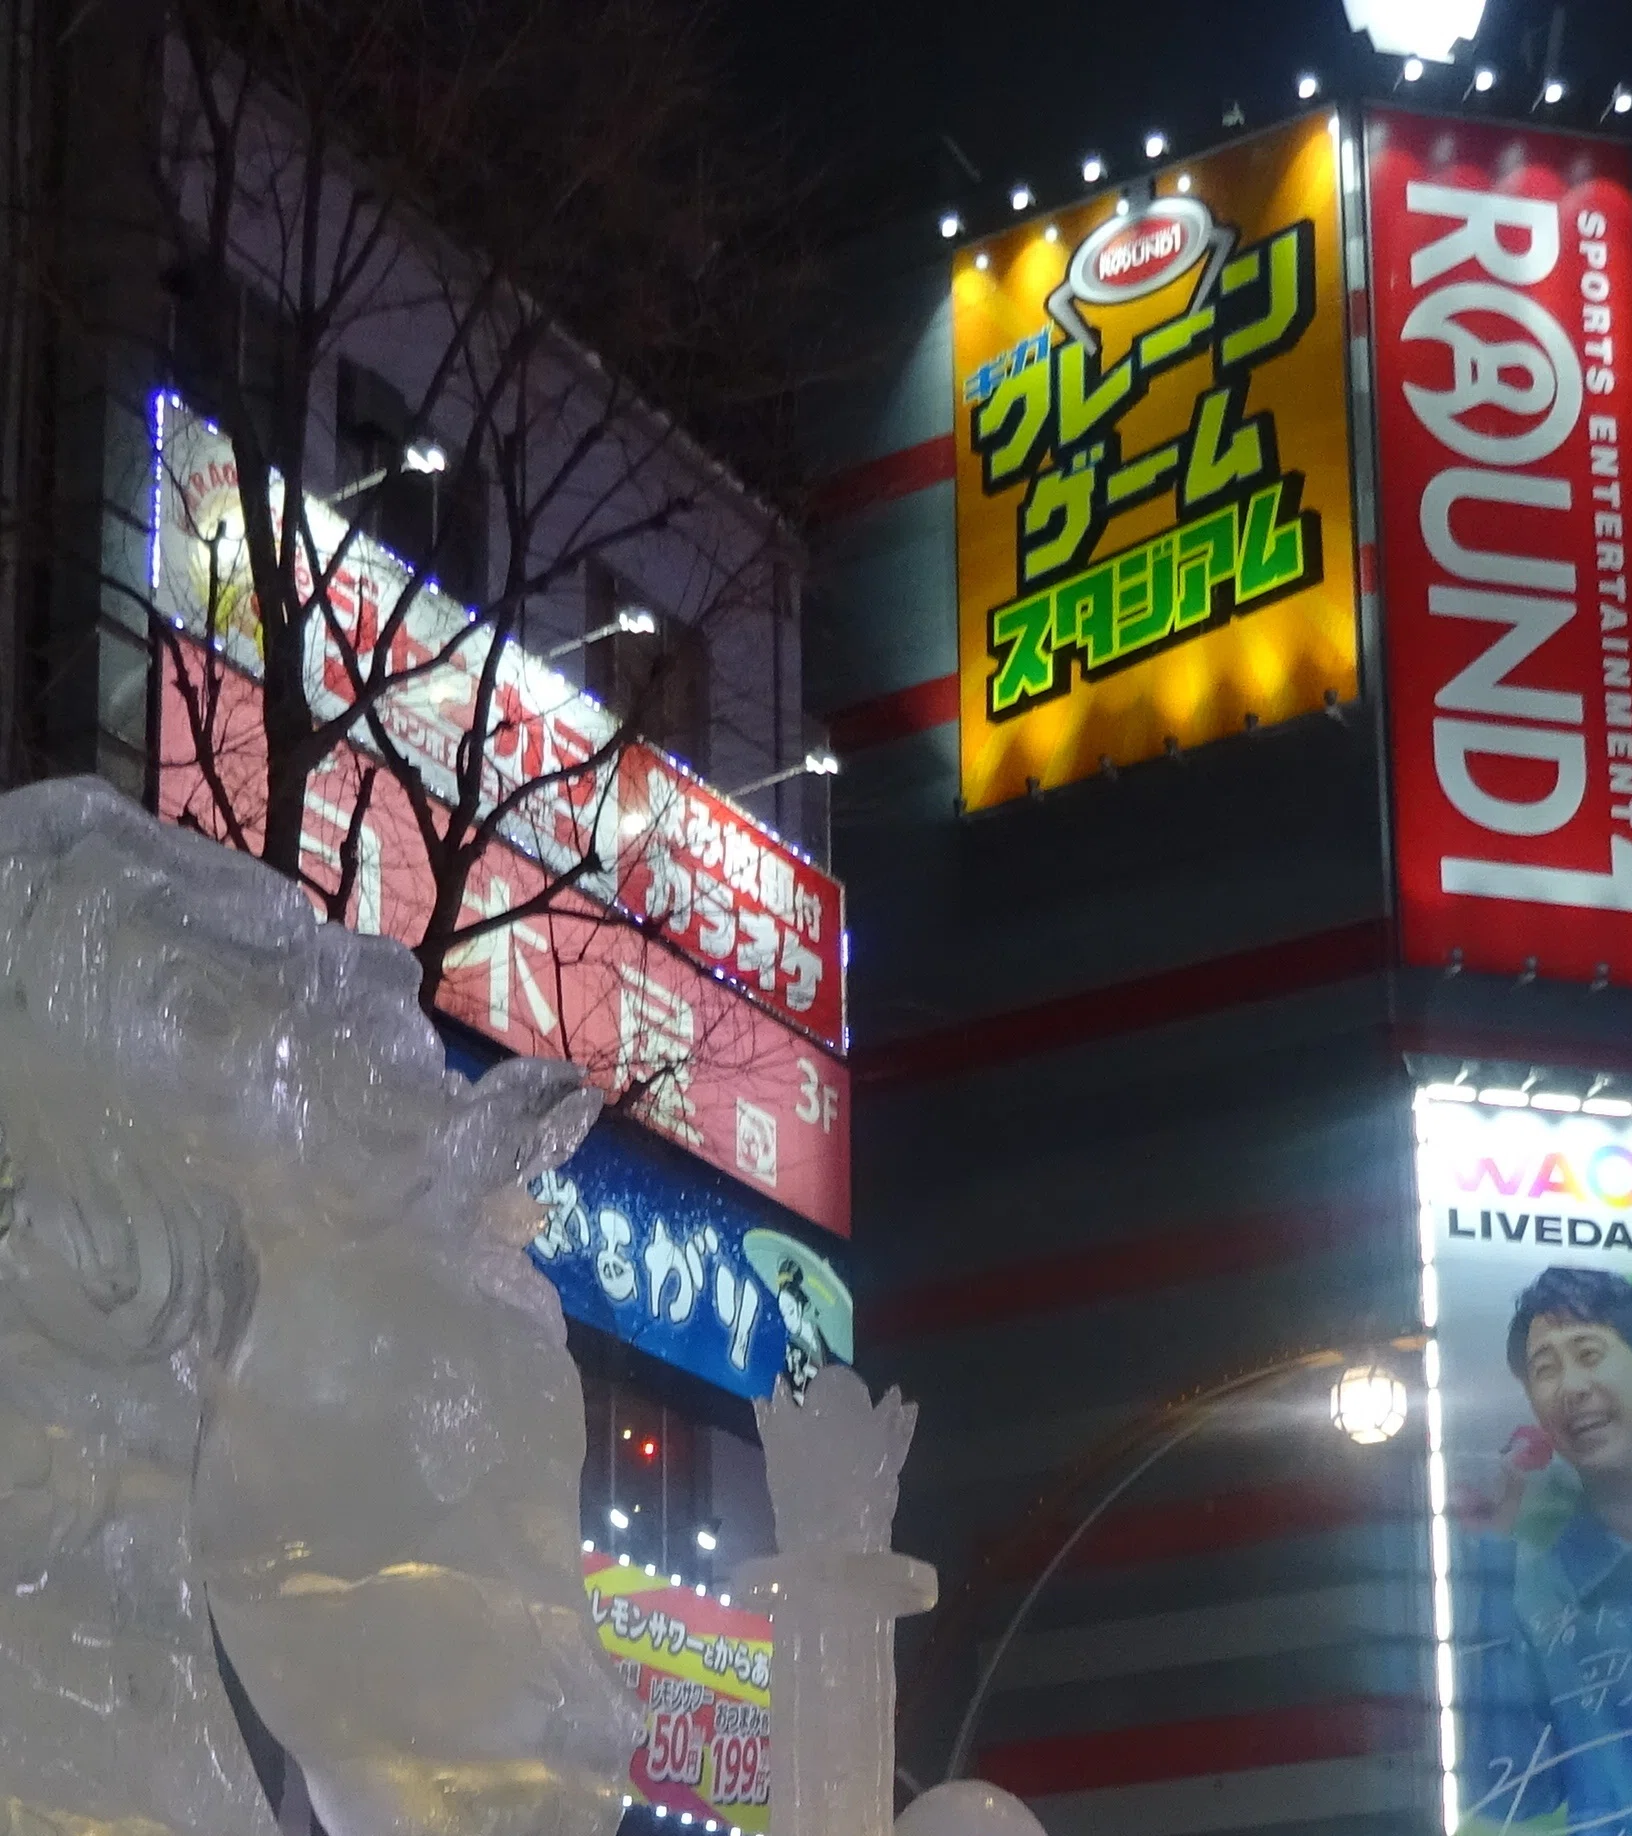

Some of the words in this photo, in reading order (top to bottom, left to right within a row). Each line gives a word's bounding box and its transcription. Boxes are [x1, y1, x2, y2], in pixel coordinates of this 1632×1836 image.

[977, 228, 1308, 480] クレーン
[1576, 209, 1615, 398] SPORTS
[1022, 390, 1274, 580] ゲーム
[990, 487, 1313, 716] スタジアム
[644, 845, 824, 1012] カラオケ
[795, 1058, 839, 1133] 3F
